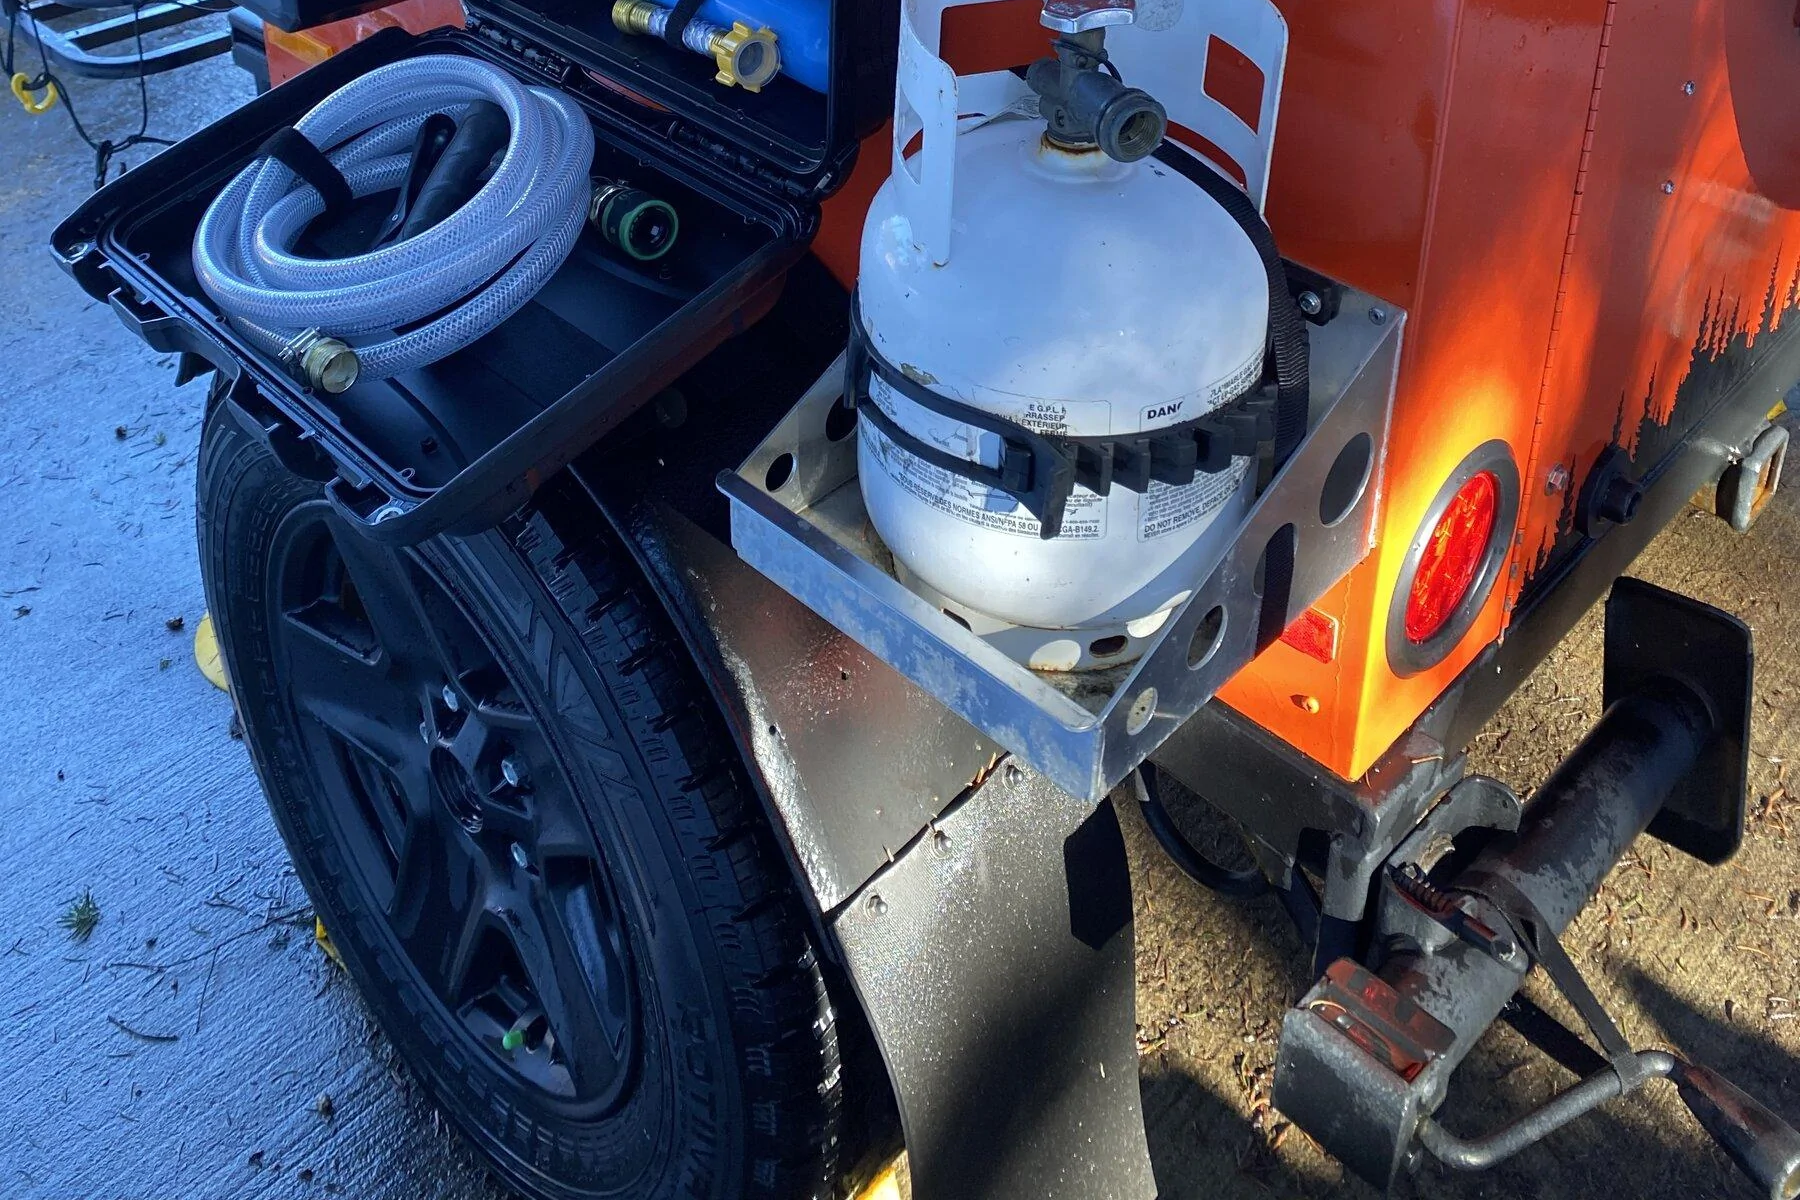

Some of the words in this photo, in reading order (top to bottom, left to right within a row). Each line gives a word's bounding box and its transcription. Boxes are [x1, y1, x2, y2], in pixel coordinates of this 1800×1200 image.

[952, 503, 980, 519] NORMES
[981, 512, 1017, 529] ANSI/NFPA
[1018, 521, 1026, 530] 58
[1027, 522, 1039, 531] OU
[1144, 524, 1155, 533] DO
[1157, 519, 1172, 529] NOT
[1202, 492, 1224, 510] DEFACE
[1143, 530, 1161, 538] NEVER
